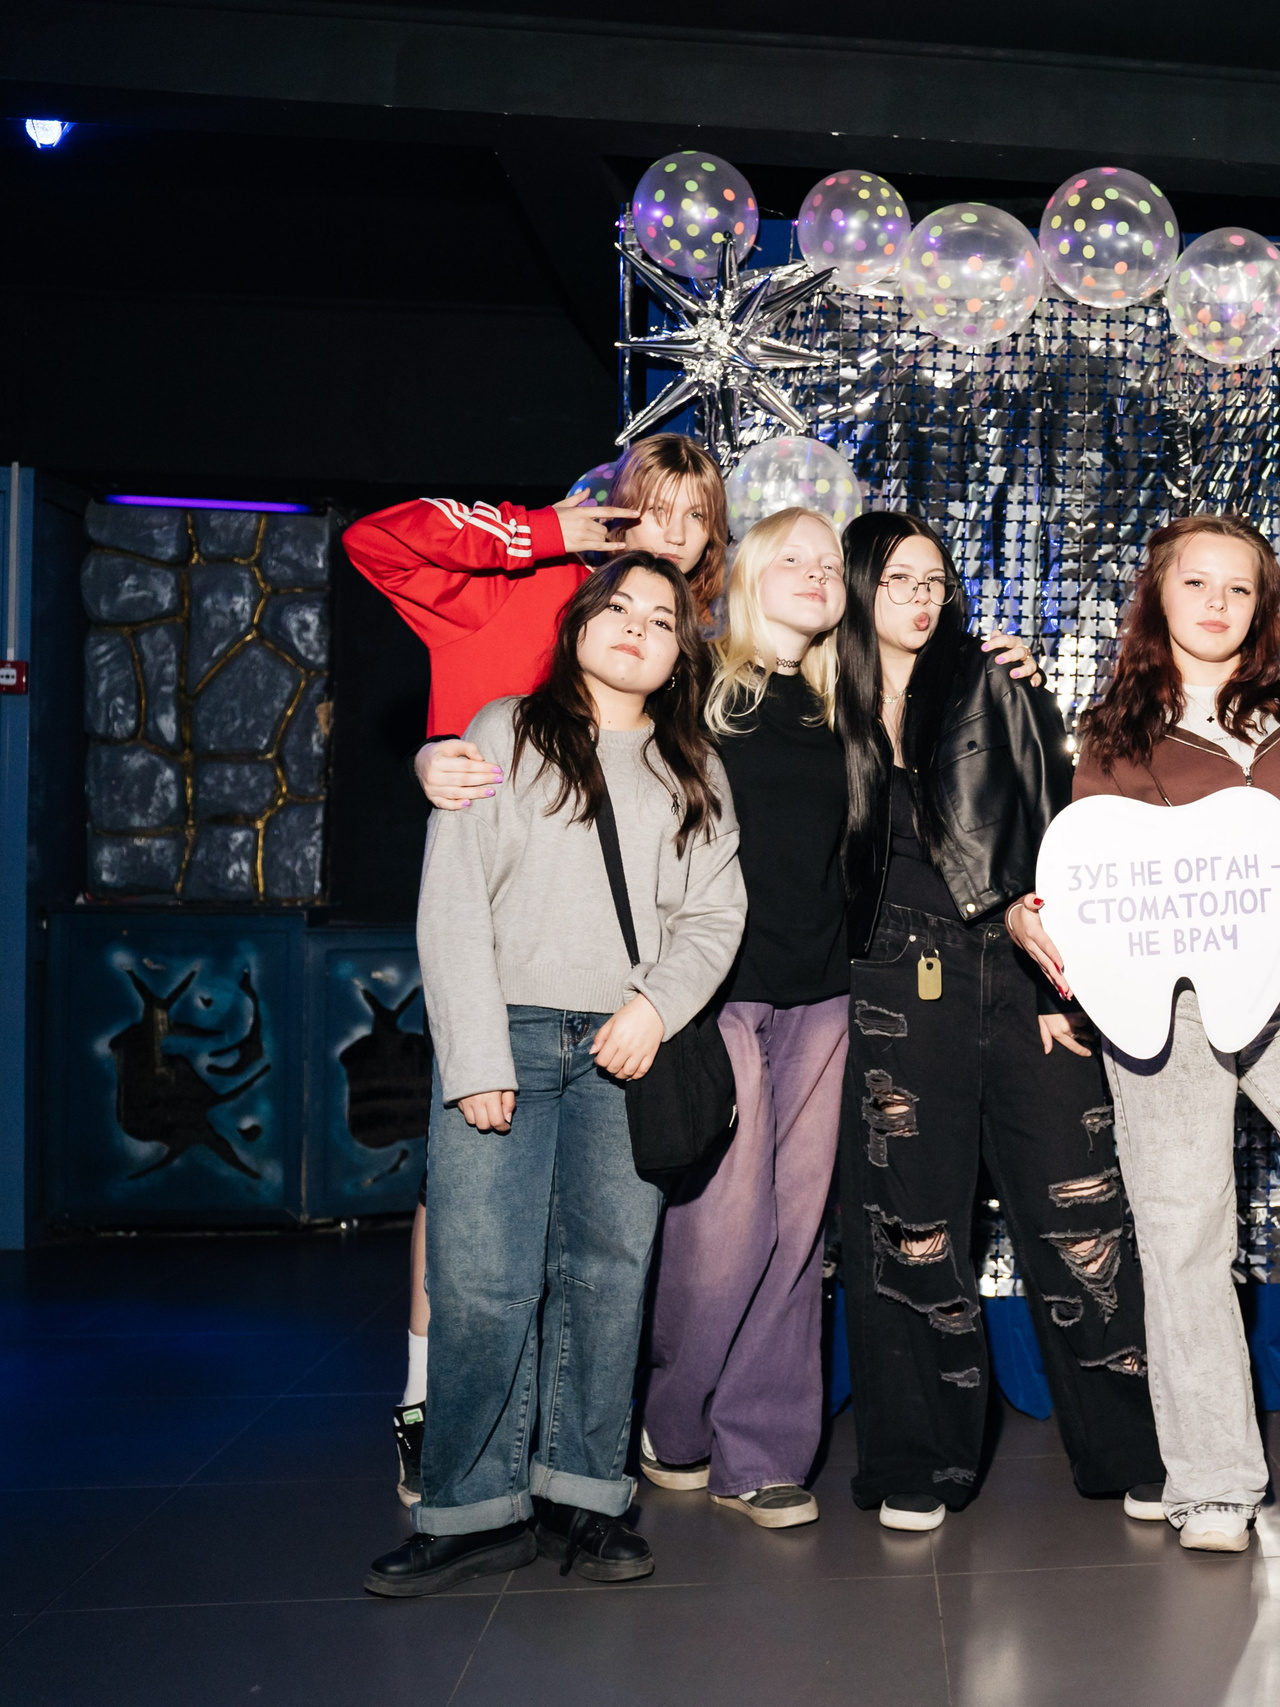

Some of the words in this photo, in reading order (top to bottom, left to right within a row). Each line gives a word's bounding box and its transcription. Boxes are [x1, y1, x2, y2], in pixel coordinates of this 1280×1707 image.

[1067, 862, 1118, 891] ЗУБ
[1130, 860, 1163, 887] НЕ
[1174, 854, 1260, 884] ОРГАН
[1077, 887, 1272, 925] СТОМАТОЛОГ
[1128, 930, 1161, 957] НЕ
[1174, 924, 1238, 955] ВРАЧ
